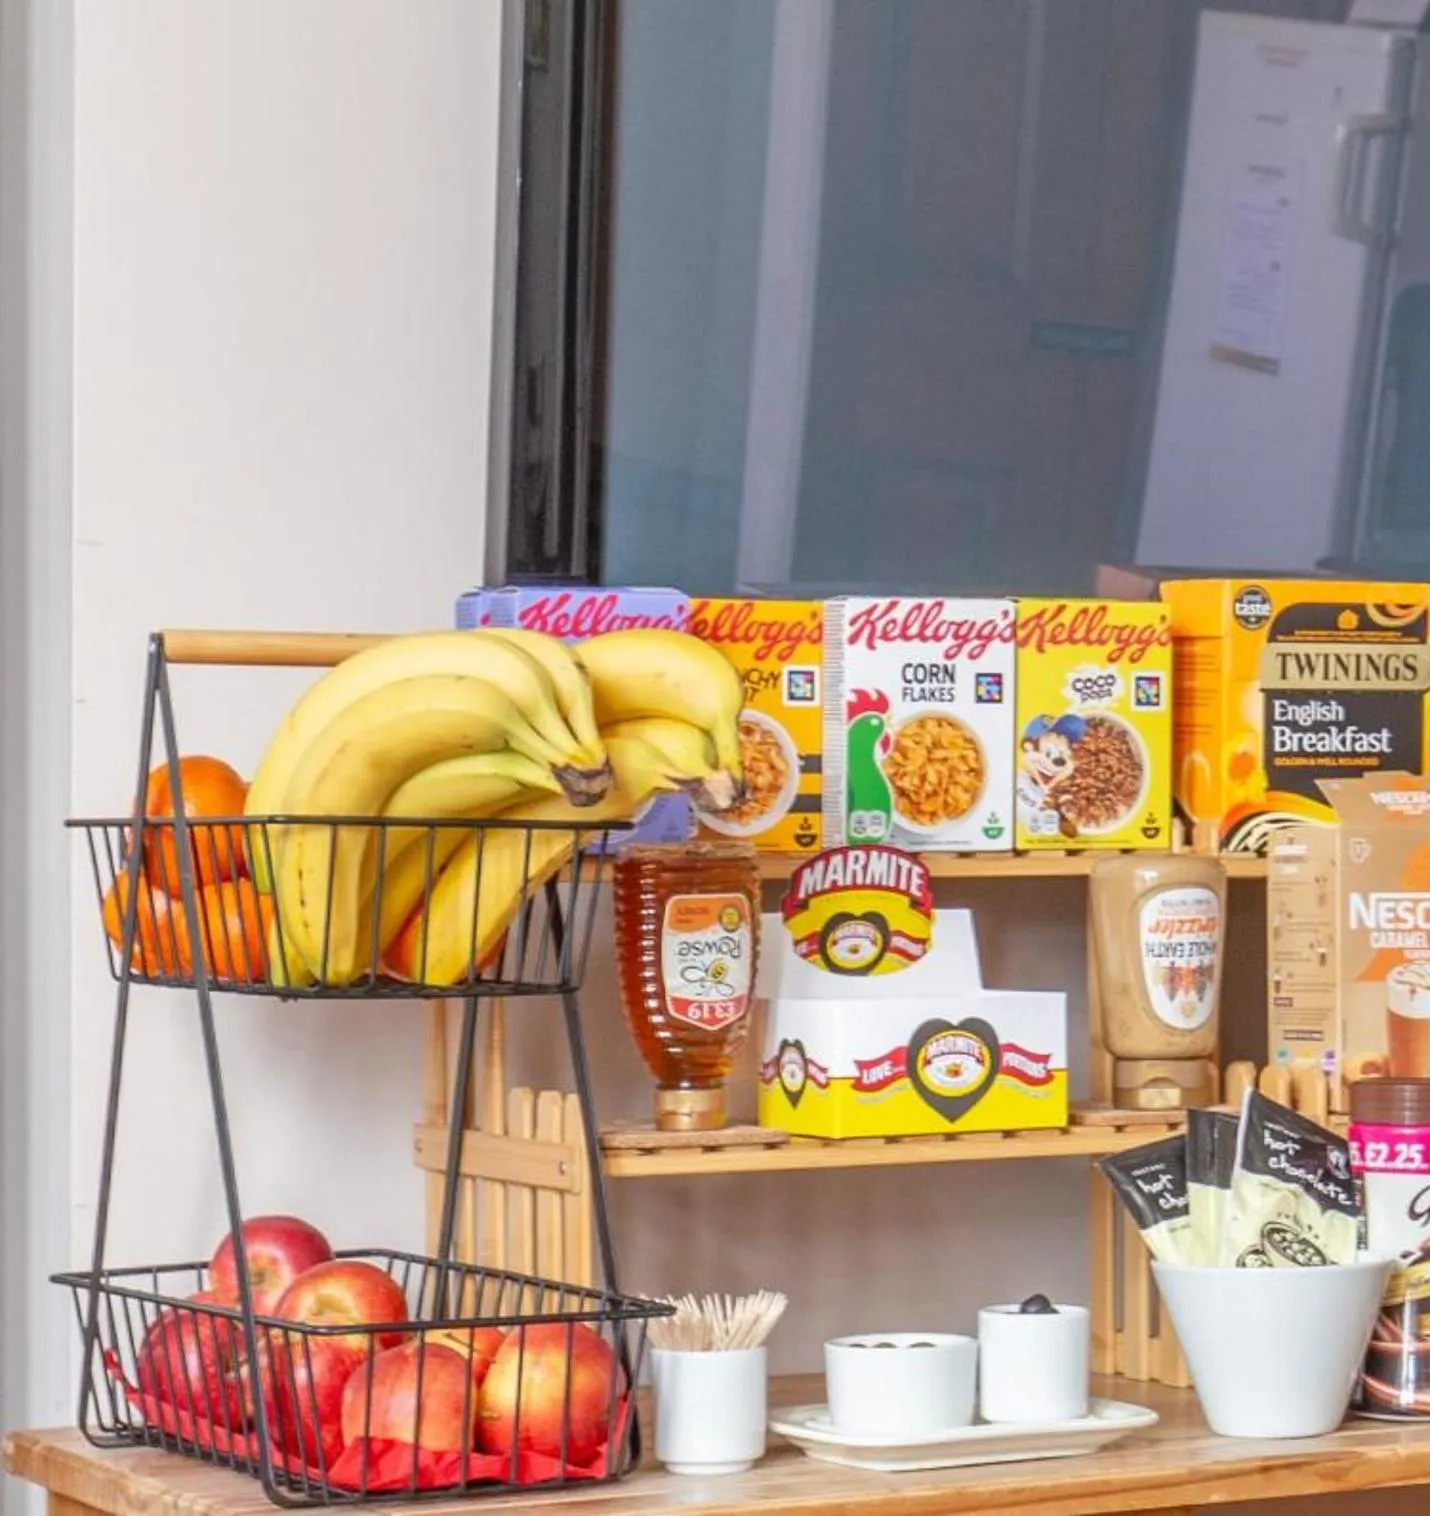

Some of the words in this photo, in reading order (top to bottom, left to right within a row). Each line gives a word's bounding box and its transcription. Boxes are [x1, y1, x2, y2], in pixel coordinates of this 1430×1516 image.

[848, 598, 1015, 661] Kellogg's
[1014, 603, 1174, 664] Kellogg's
[902, 662, 956, 684] CORN
[1276, 652, 1419, 683] TWININGS
[902, 686, 955, 702] FLAKES
[1273, 700, 1345, 727] English
[1272, 725, 1393, 753] Breakfast
[798, 850, 925, 898] MARMITE
[675, 934, 742, 960] Rowse
[1369, 930, 1430, 949] CARAMEL
[687, 1001, 736, 1020] £3.19
[1263, 1128, 1302, 1156] hot
[1136, 1172, 1176, 1194] hot
[1267, 1155, 1354, 1206] chocolate
